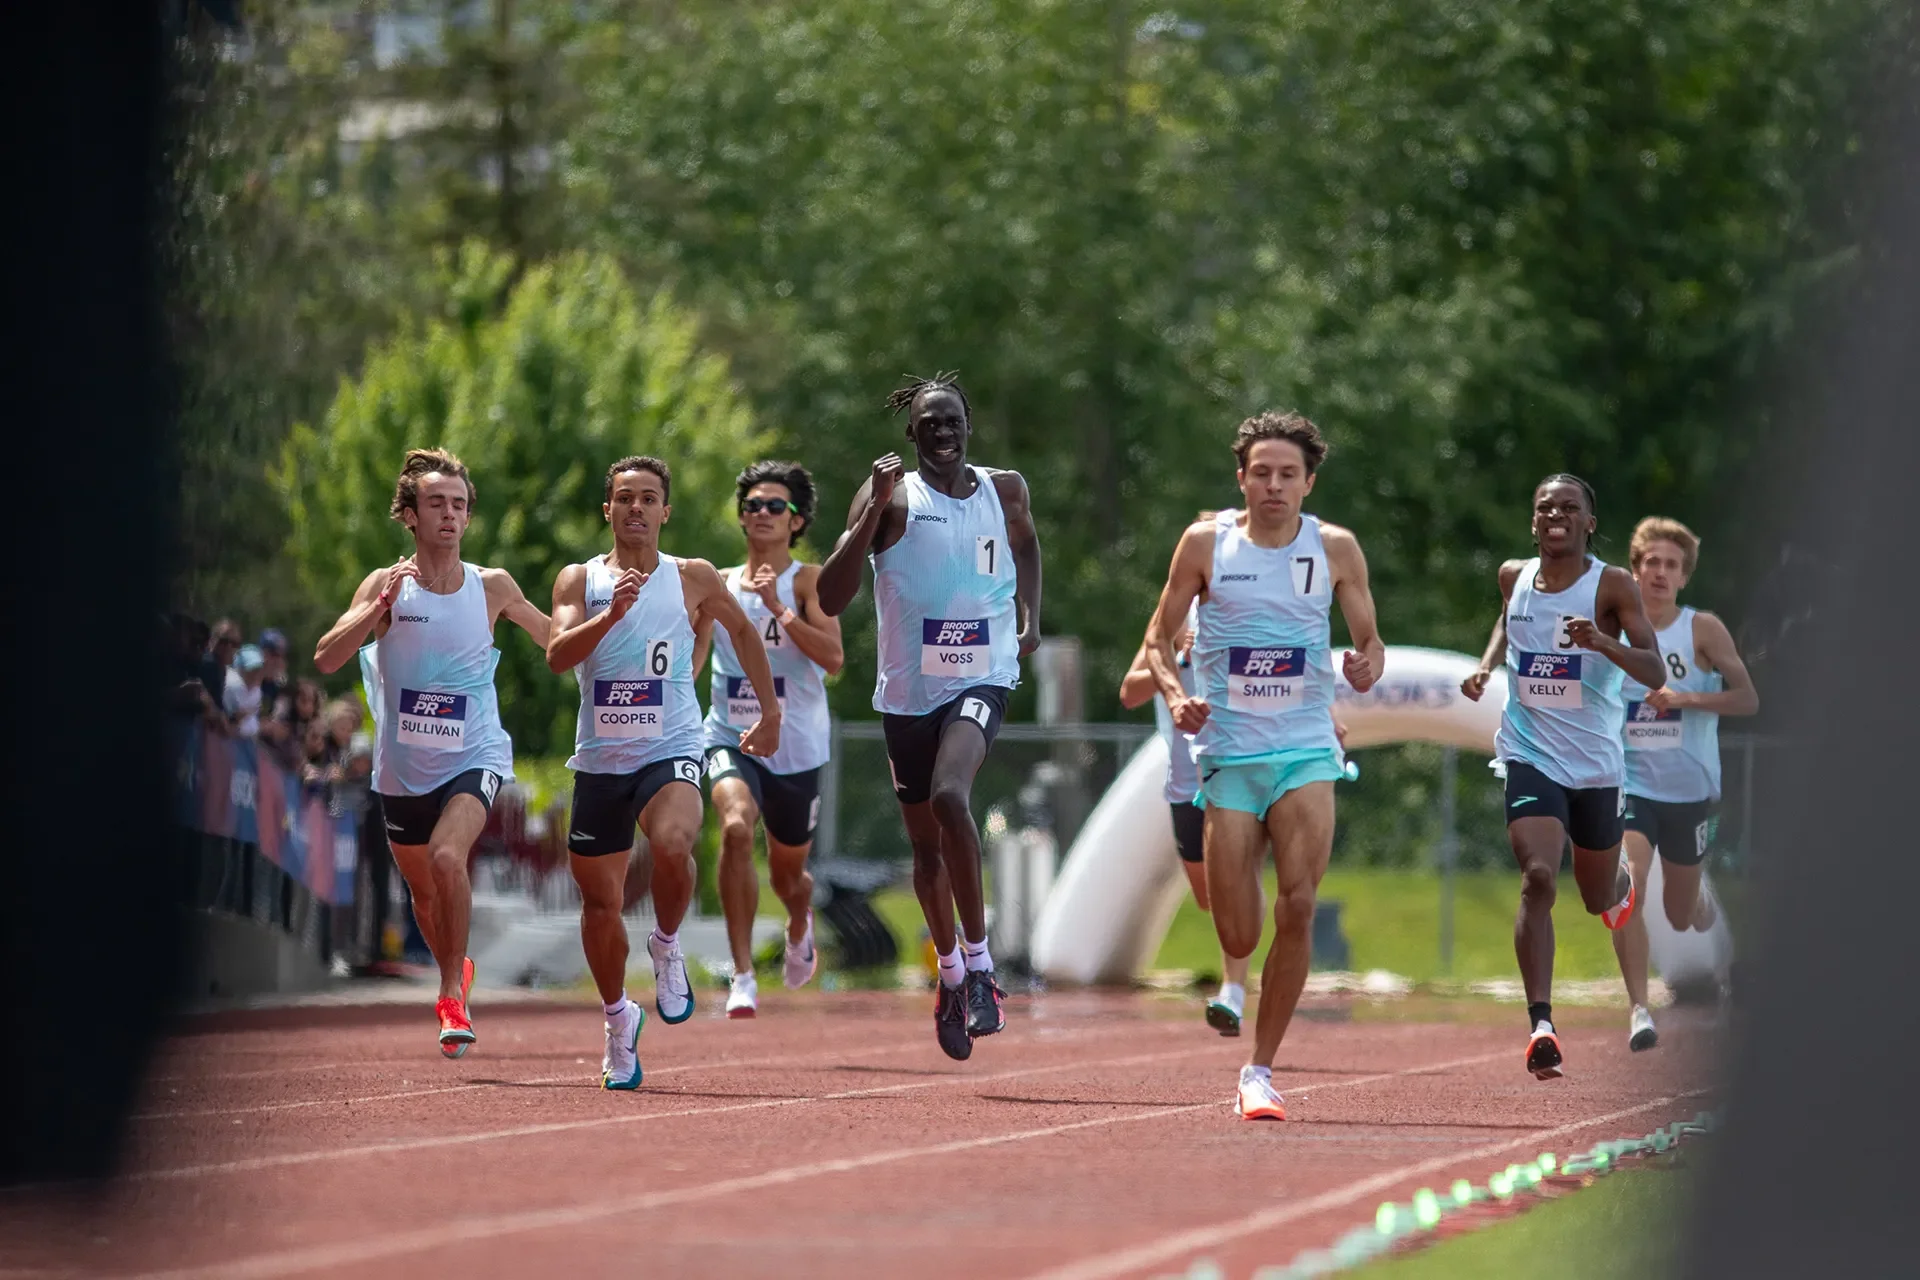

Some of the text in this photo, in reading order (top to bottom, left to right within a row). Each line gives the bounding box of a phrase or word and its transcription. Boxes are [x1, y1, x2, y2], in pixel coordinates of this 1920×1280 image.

[914, 514, 948, 524] BROOKS
[983, 539, 995, 574] 1
[1220, 573, 1258, 583] BROOKS
[1296, 557, 1314, 594] 7
[398, 615, 429, 623] BROOKS
[941, 621, 980, 631] BROOKS
[764, 617, 781, 646] 4
[935, 630, 965, 645] PR
[651, 640, 669, 676] 6
[939, 652, 974, 664] VOSS
[1249, 650, 1293, 659] BROOKS
[1533, 654, 1570, 665] BROOKS
[1242, 659, 1276, 676] PR
[1528, 662, 1554, 678] PR
[1666, 652, 1687, 680] 8
[611, 681, 650, 691] BROOKS
[1243, 683, 1292, 697] SMITH
[1528, 683, 1567, 697] KELLY
[418, 693, 456, 704] BROOKS
[605, 690, 633, 705] PR
[412, 700, 439, 716] PR
[971, 700, 985, 720] 1
[600, 712, 657, 725] COOPER
[401, 719, 461, 738] SULLIVAN
[1629, 726, 1680, 740] MCDONALD
[680, 761, 697, 781] 6
[486, 775, 498, 799] 5
